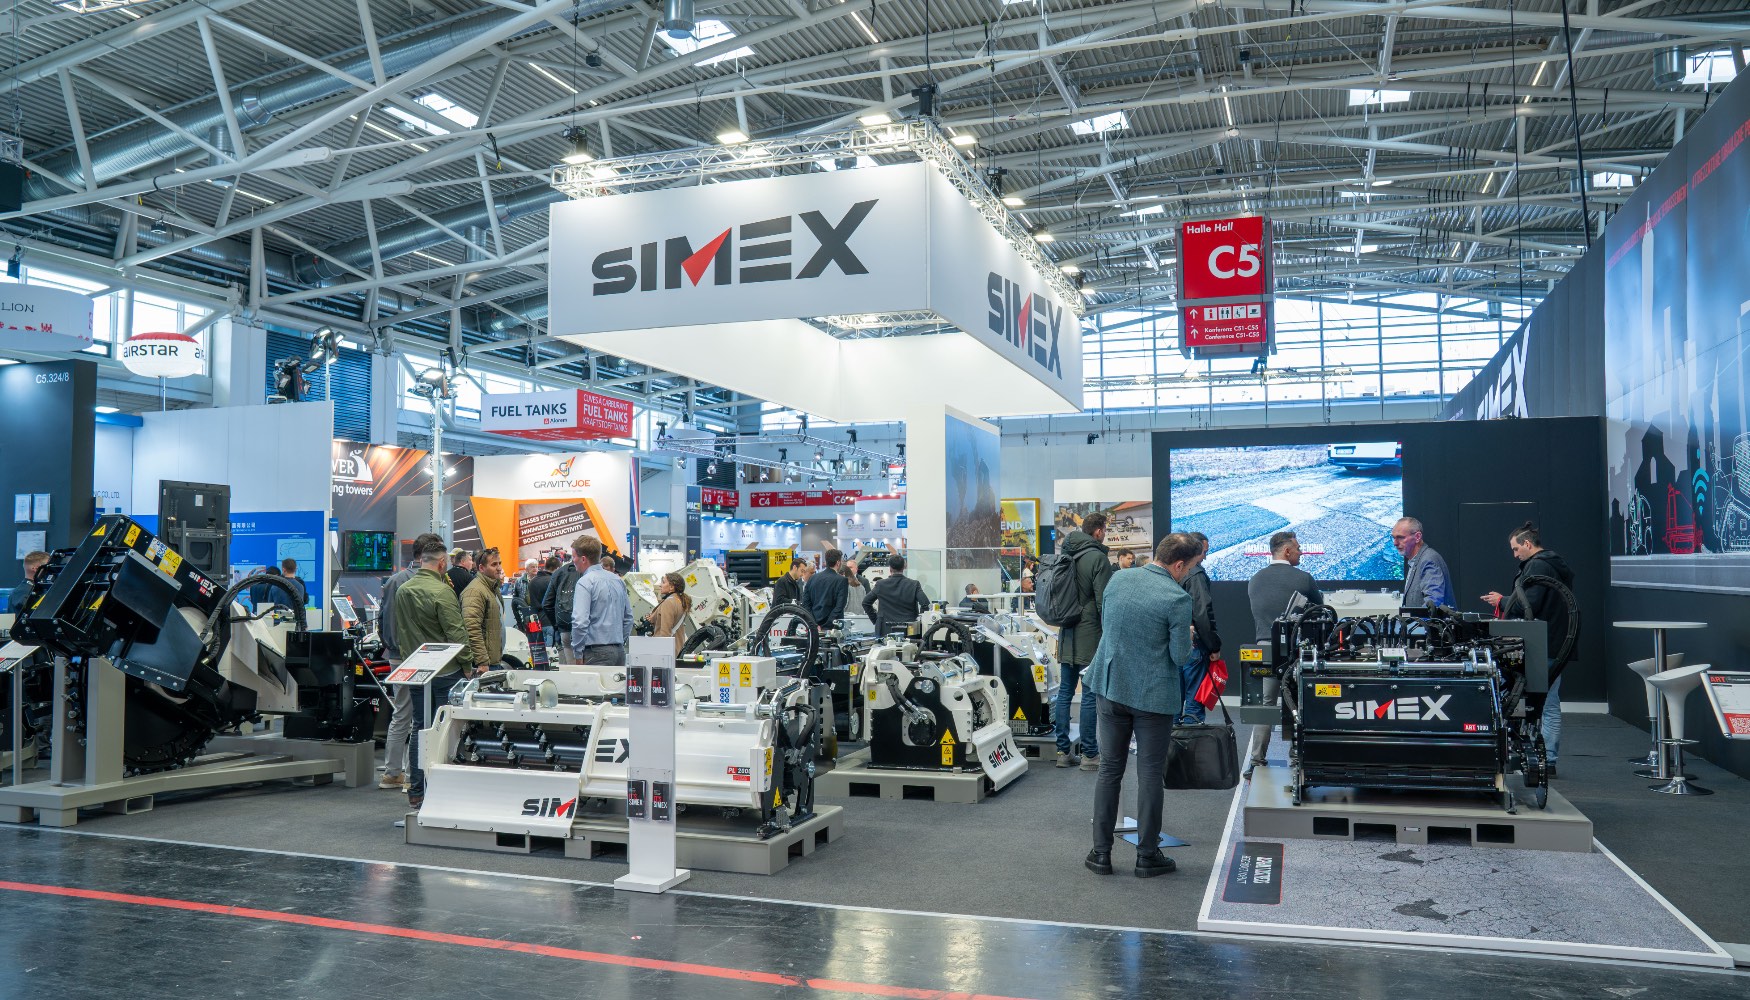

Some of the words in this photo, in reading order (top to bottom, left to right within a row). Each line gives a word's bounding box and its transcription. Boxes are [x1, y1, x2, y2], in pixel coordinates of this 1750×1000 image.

[1186, 224, 1212, 234] Halle
[1214, 221, 1234, 233] Hall
[591, 198, 879, 297] SIMEX
[1208, 243, 1260, 279] C5
[986, 271, 1063, 380] SIMEX
[36, 372, 70, 384] C5.324/8
[491, 406, 522, 417] FUEL
[525, 403, 567, 416] TANKS
[583, 403, 603, 418] FUEL
[604, 407, 628, 424] TANKS
[345, 484, 373, 496] towers
[833, 495, 846, 504] C6
[758, 497, 771, 507] C4
[520, 515, 540, 527] ERASES
[539, 510, 561, 520] EFFORT
[521, 522, 549, 535] MINIMIZES
[548, 517, 568, 529] INJURY
[568, 513, 585, 523] RISKS
[1000, 520, 1026, 531] END.
[522, 533, 544, 545] BOOSTS
[544, 523, 583, 539] PRODUCTIVITY
[188, 571, 218, 594] SIMEX
[1334, 694, 1453, 721] SIMEX
[988, 738, 1015, 769] SIMEX
[521, 797, 577, 819] SIM
